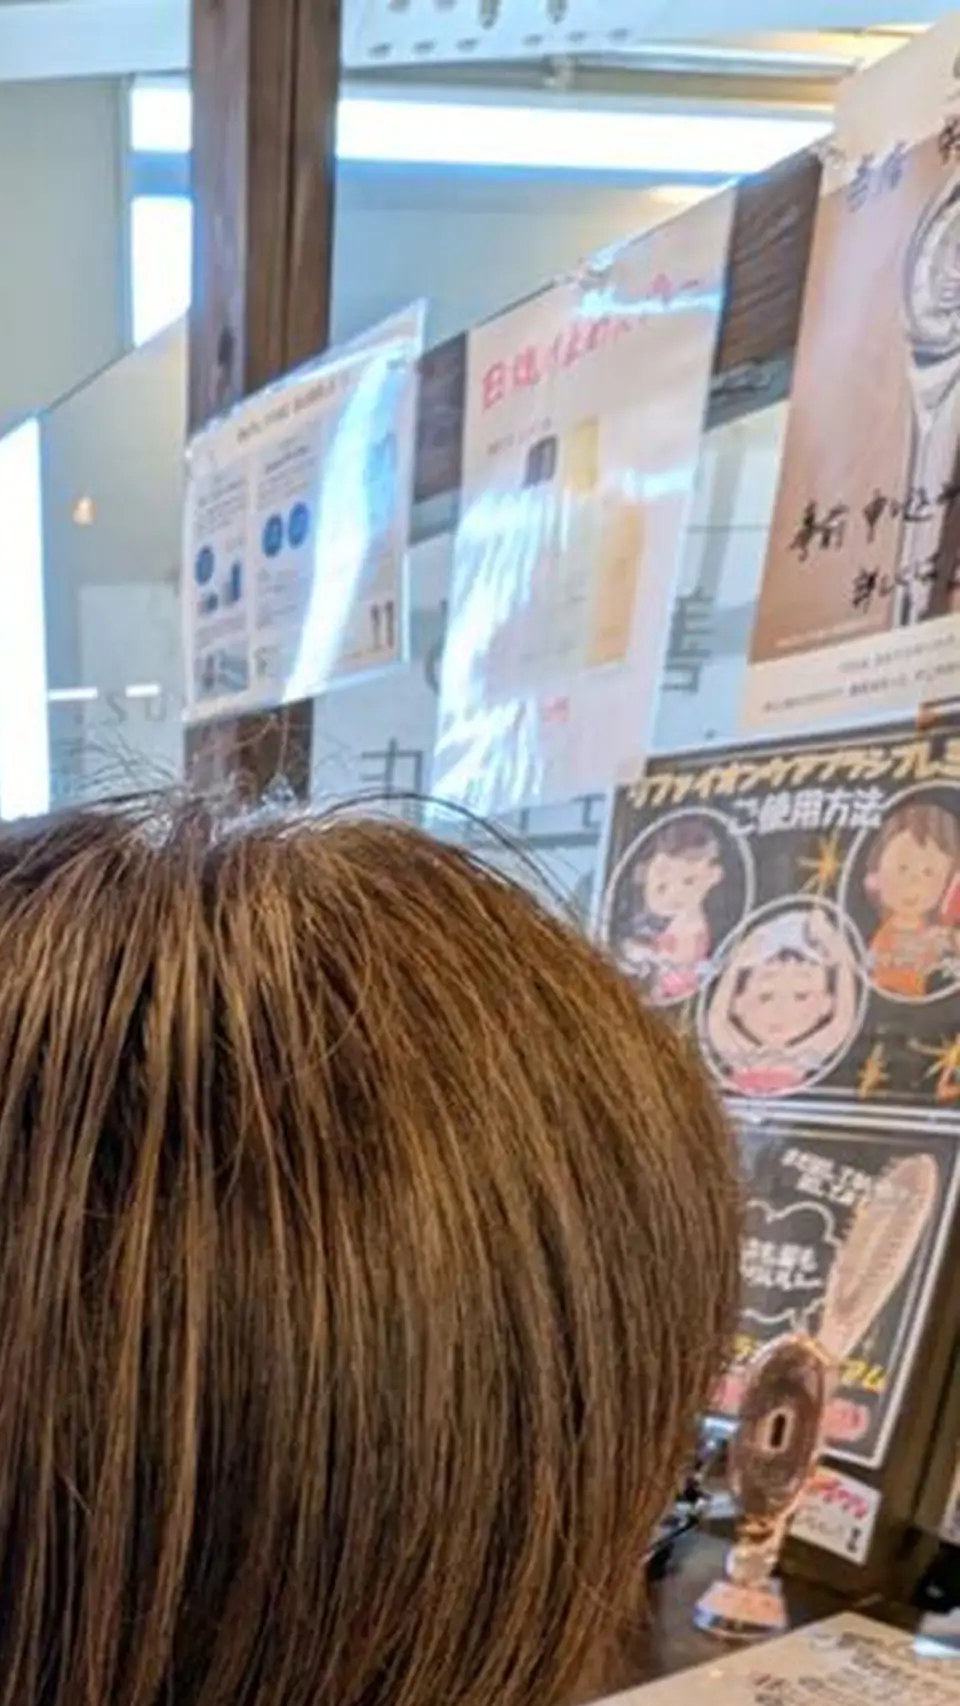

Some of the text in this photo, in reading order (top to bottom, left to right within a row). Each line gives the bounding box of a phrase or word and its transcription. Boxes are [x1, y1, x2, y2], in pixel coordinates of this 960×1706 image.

[730, 785, 888, 836] ご使用方法
